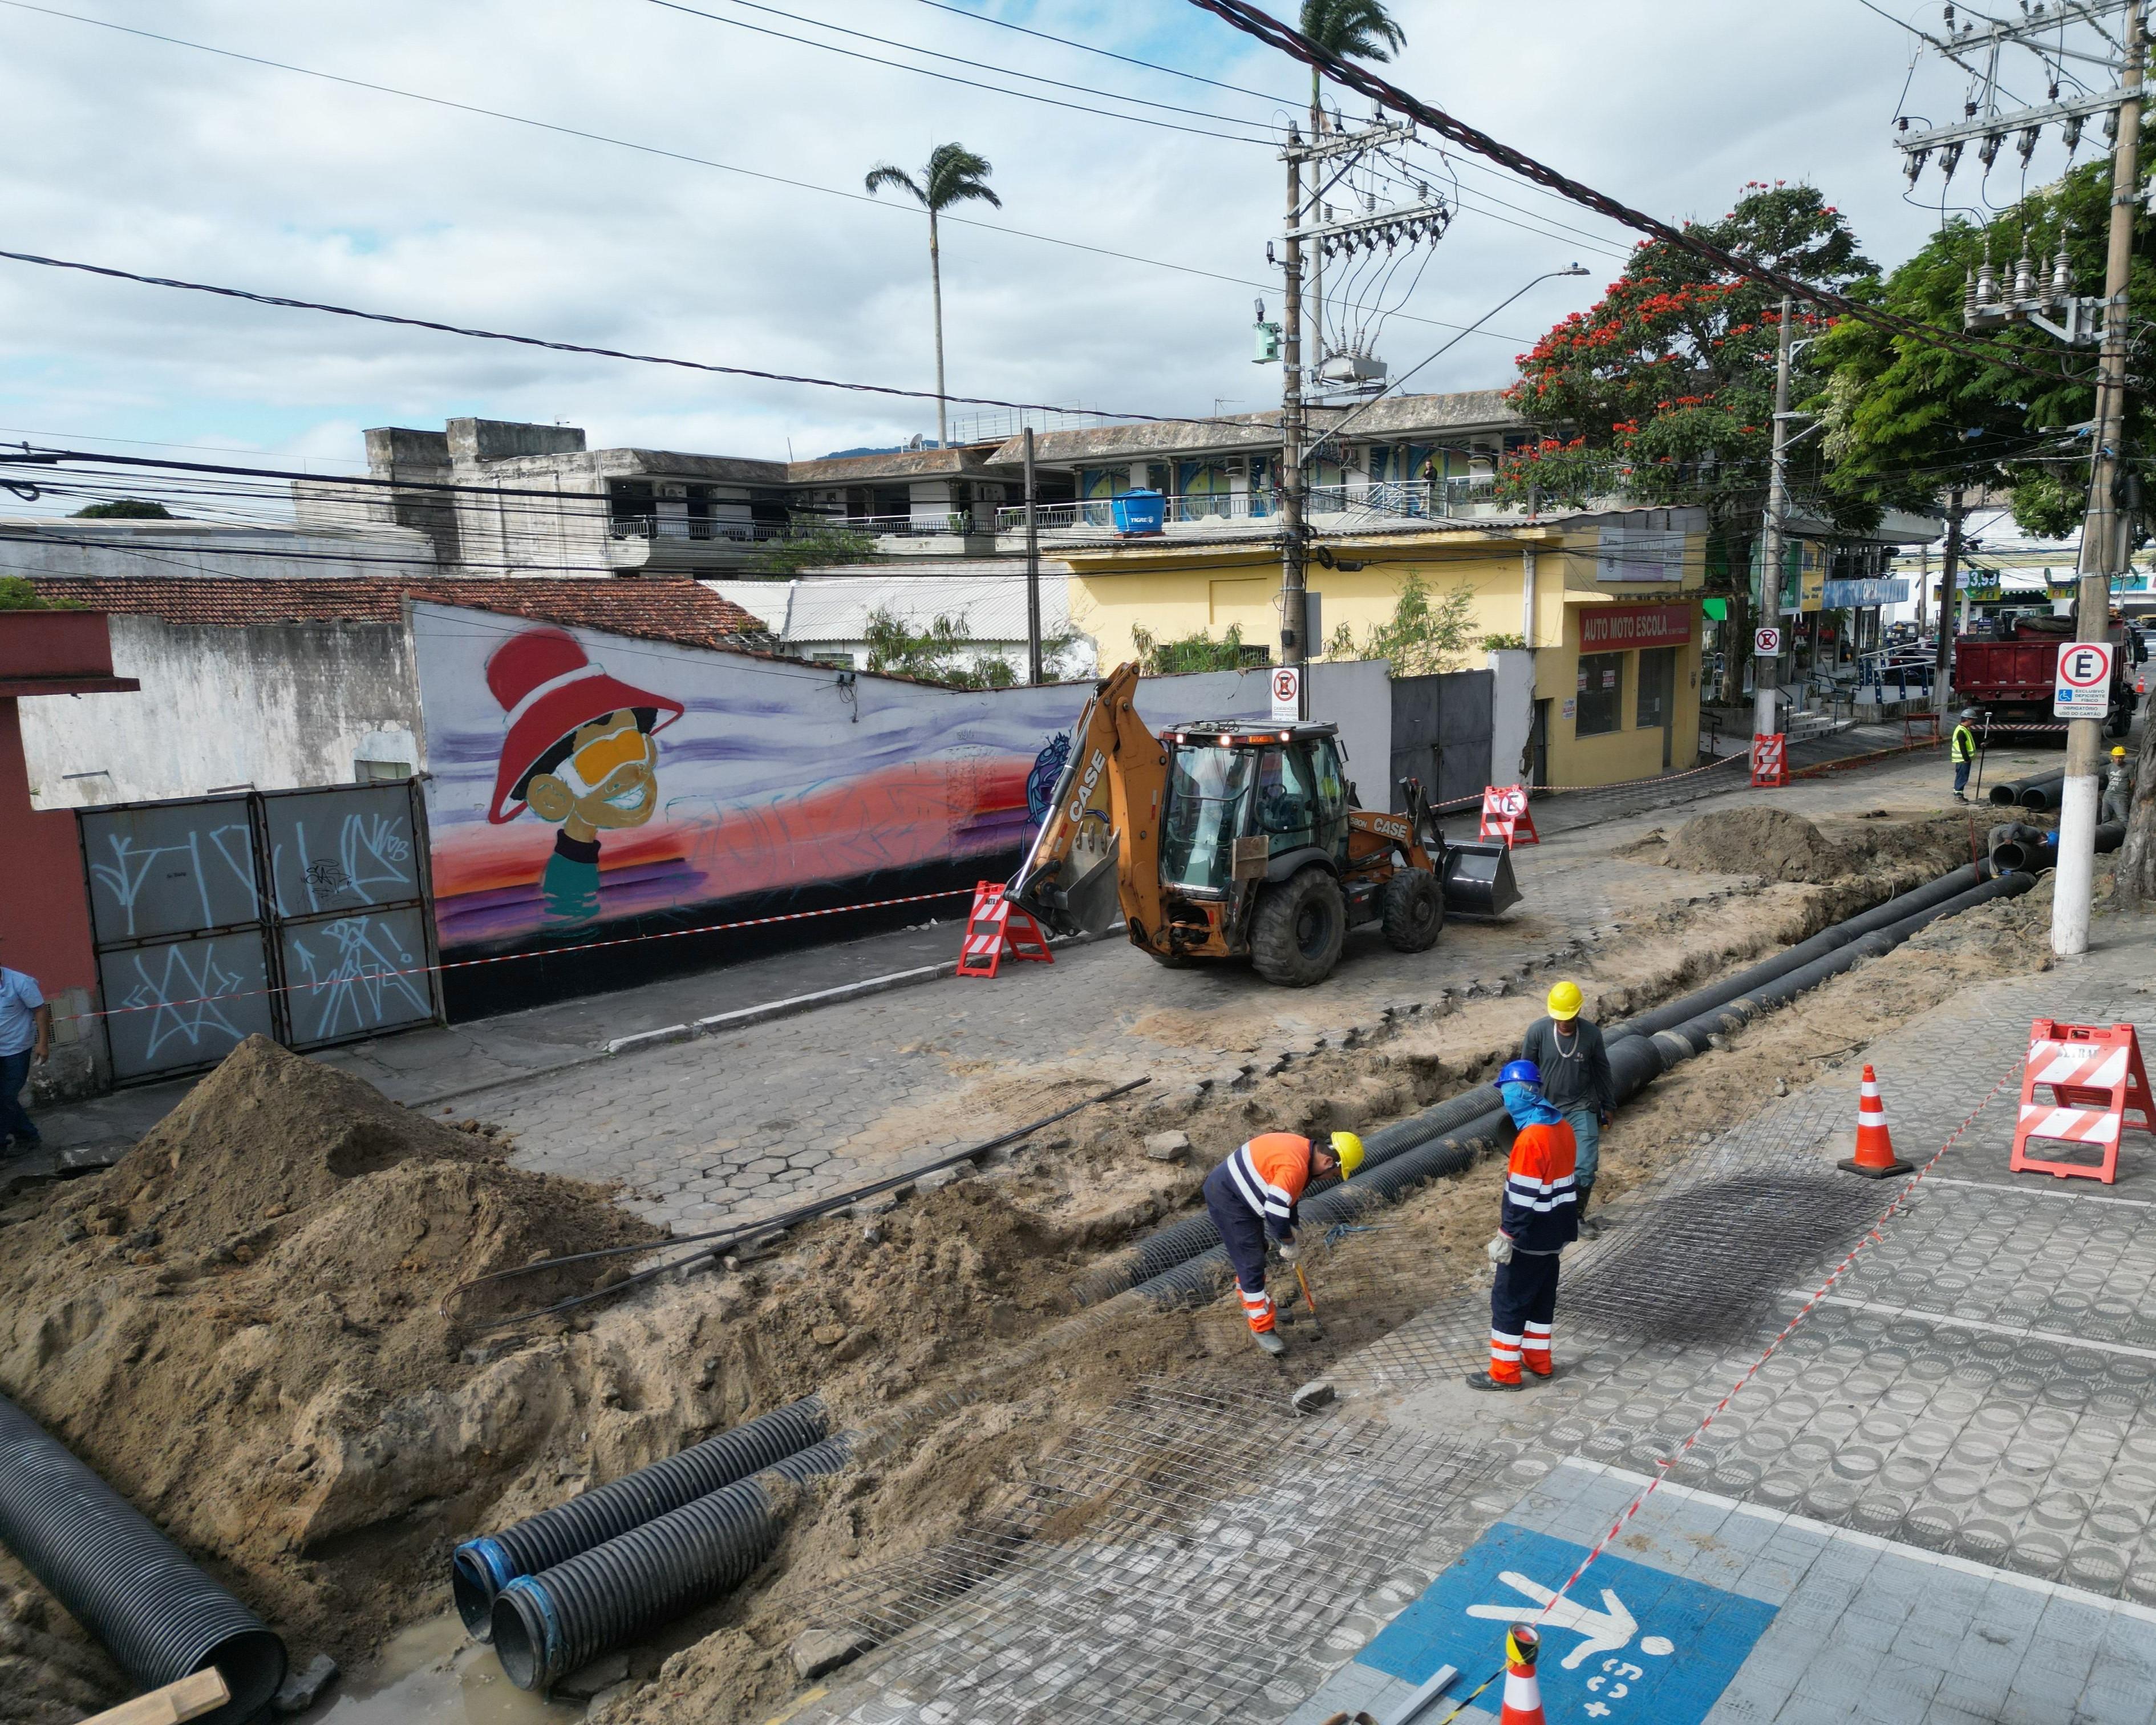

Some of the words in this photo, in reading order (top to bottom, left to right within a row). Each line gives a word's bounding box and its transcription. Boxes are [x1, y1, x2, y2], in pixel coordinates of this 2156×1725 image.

[1584, 618, 1608, 641] AUTO
[1610, 617, 1634, 639] MOTO
[1636, 615, 1667, 637] ESCOLA
[2075, 654, 2093, 677] E
[1069, 748, 1106, 822] CASE
[1373, 817, 1408, 839] CASE
